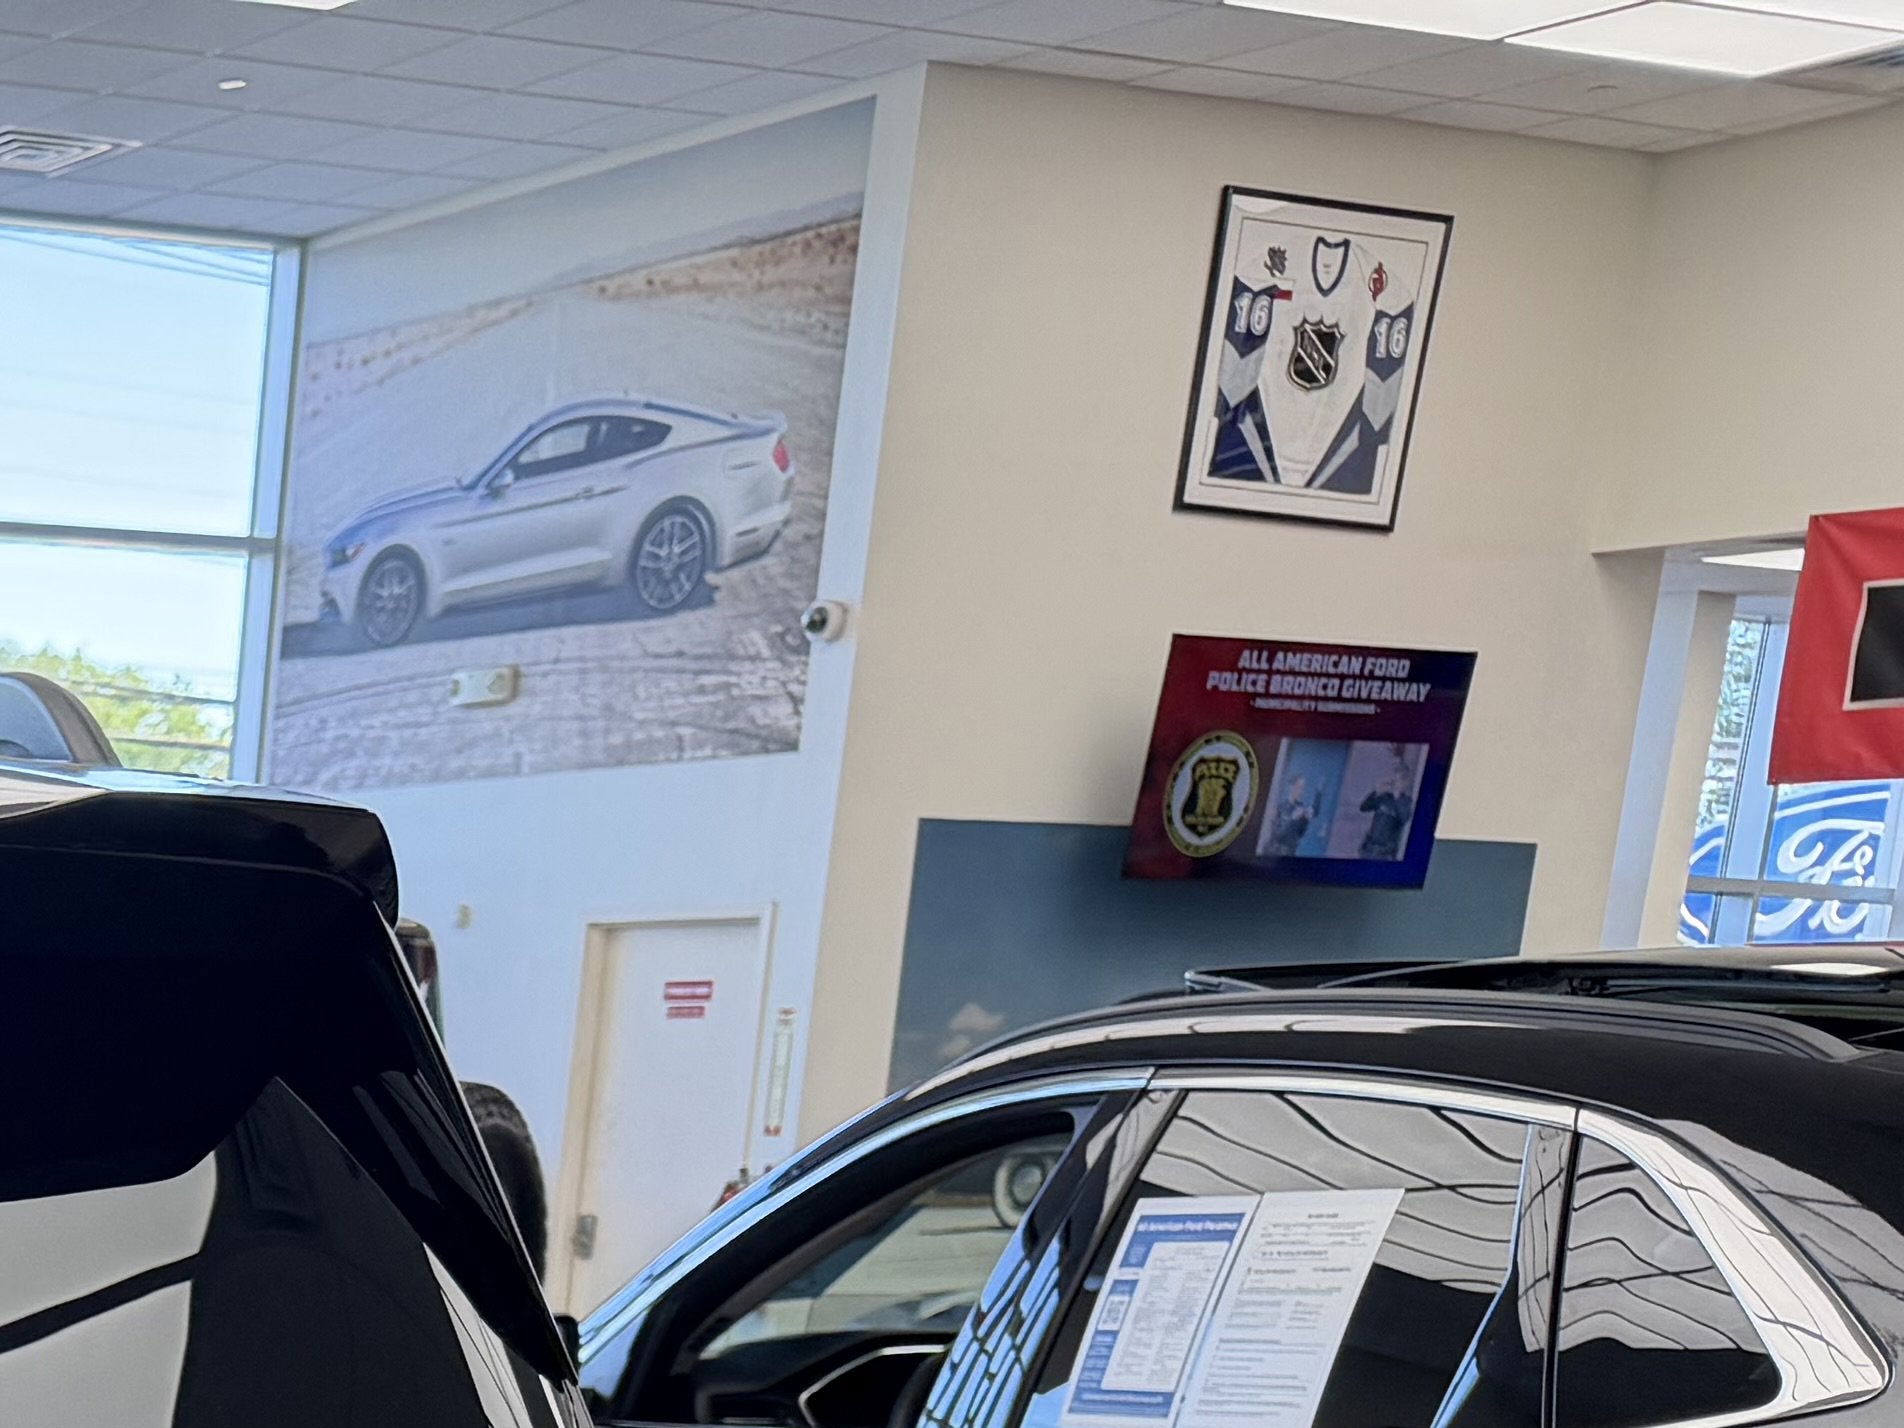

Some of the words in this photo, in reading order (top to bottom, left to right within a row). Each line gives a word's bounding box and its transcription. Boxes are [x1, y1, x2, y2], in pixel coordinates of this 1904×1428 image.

[1234, 292, 1273, 336] 16
[1374, 317, 1408, 359] 16
[1238, 649, 1269, 670] ALL
[1271, 650, 1361, 676] AMERICAN
[1364, 658, 1410, 678] FORD
[1206, 671, 1266, 693] POLICE
[1269, 673, 1339, 698] BRONCO
[1341, 680, 1431, 703] GIVEAWAY
